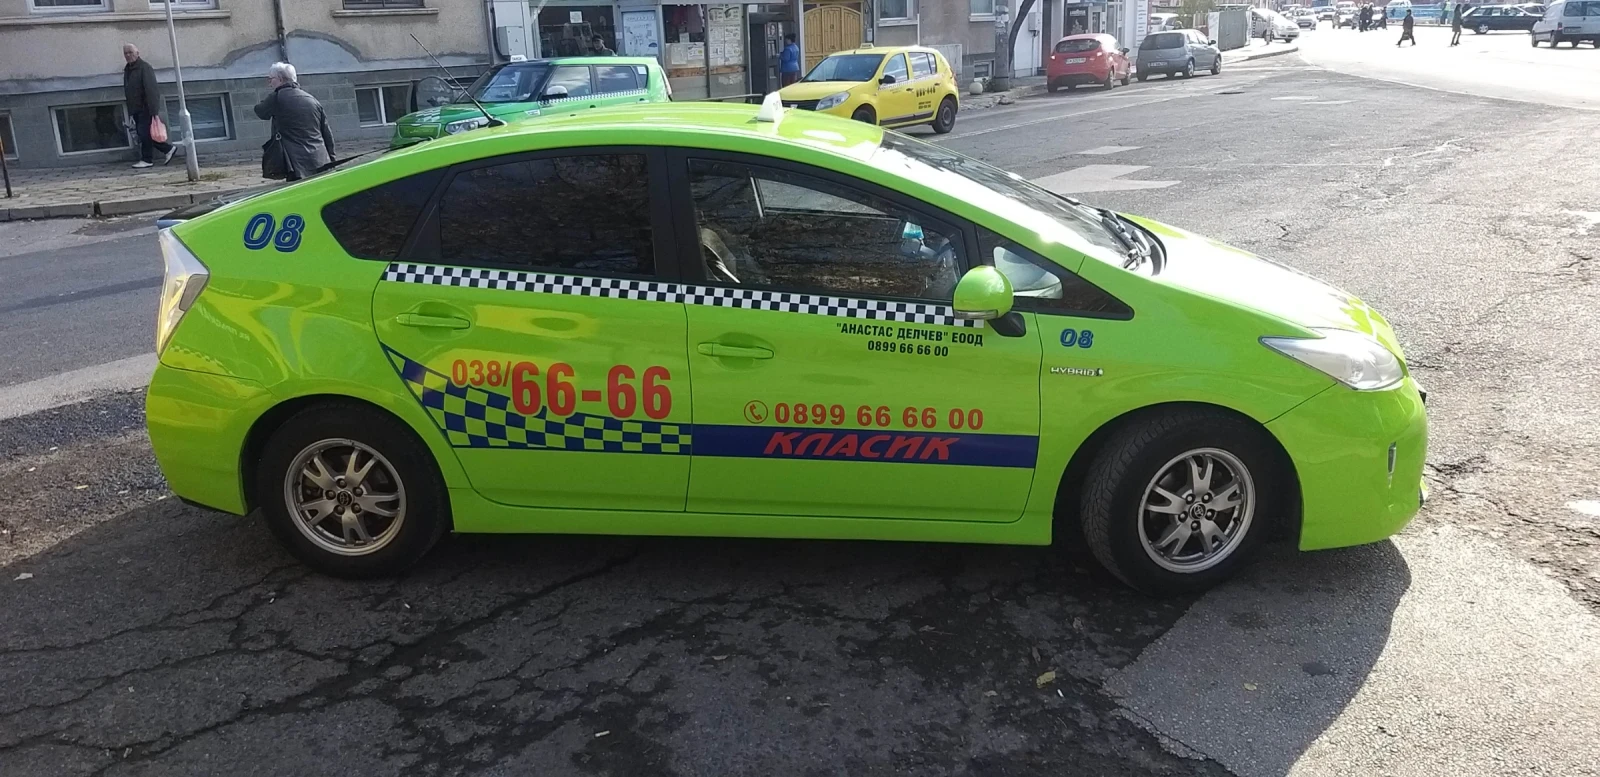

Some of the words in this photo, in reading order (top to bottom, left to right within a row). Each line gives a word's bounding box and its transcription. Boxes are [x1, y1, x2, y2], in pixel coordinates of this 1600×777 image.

[243, 212, 306, 253] 08
[836, 322, 894, 338] "АНАСТАС
[896, 327, 949, 342] ДЕЛЧЕВ"
[951, 332, 984, 347] ЕООД
[1060, 328, 1094, 348] 08
[867, 340, 897, 353] 0899
[899, 343, 914, 354] 66
[916, 344, 931, 356] 66
[934, 345, 949, 357] 00
[1050, 366, 1095, 377] HYBRID
[451, 358, 673, 421] 038/66-66
[774, 402, 846, 426] 0899
[856, 404, 891, 427] 66
[902, 406, 937, 429] 66
[948, 408, 984, 431] 00
[763, 431, 961, 461] КЛАСИК
